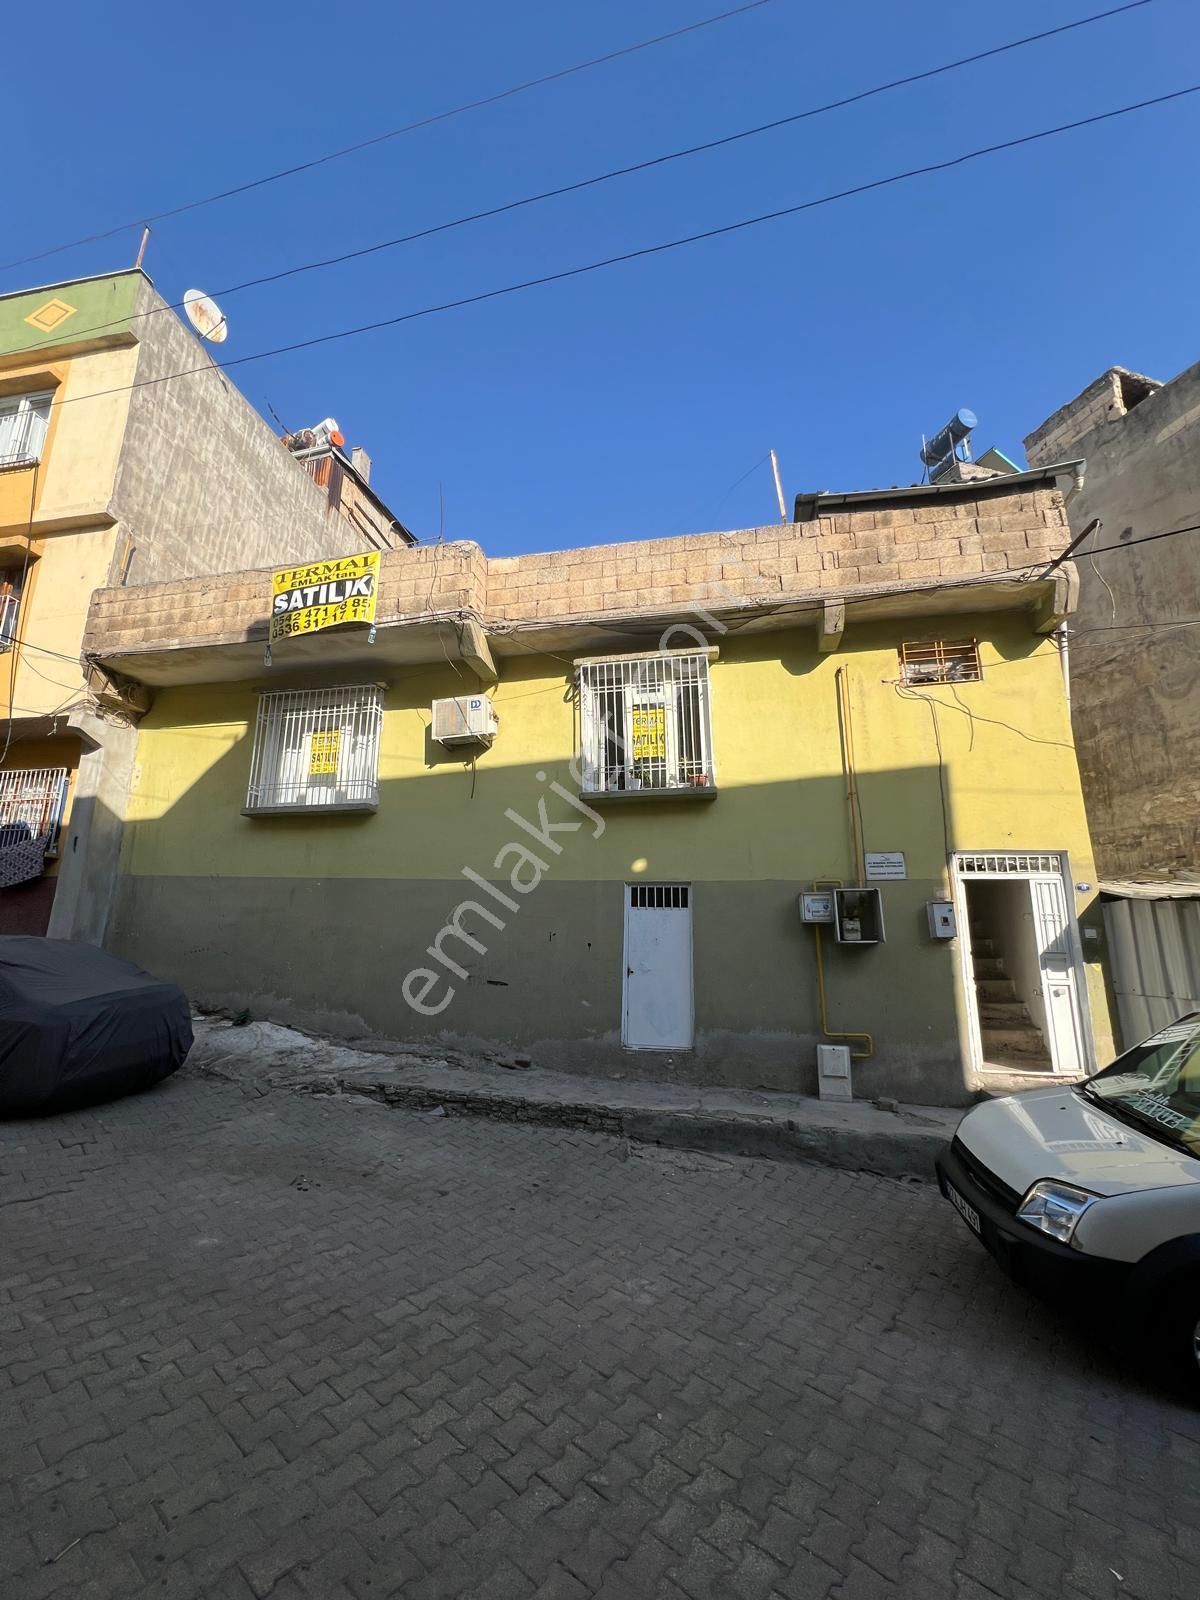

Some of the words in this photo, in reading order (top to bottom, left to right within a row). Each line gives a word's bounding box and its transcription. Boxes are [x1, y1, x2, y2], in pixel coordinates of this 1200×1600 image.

[276, 556, 376, 584] TERMAL
[290, 571, 356, 588] EMLAK'tan
[274, 574, 374, 615] SATILIK
[272, 622, 300, 639] 0536
[332, 610, 347, 622] 17
[273, 612, 301, 628] 0542
[305, 607, 328, 618] 471
